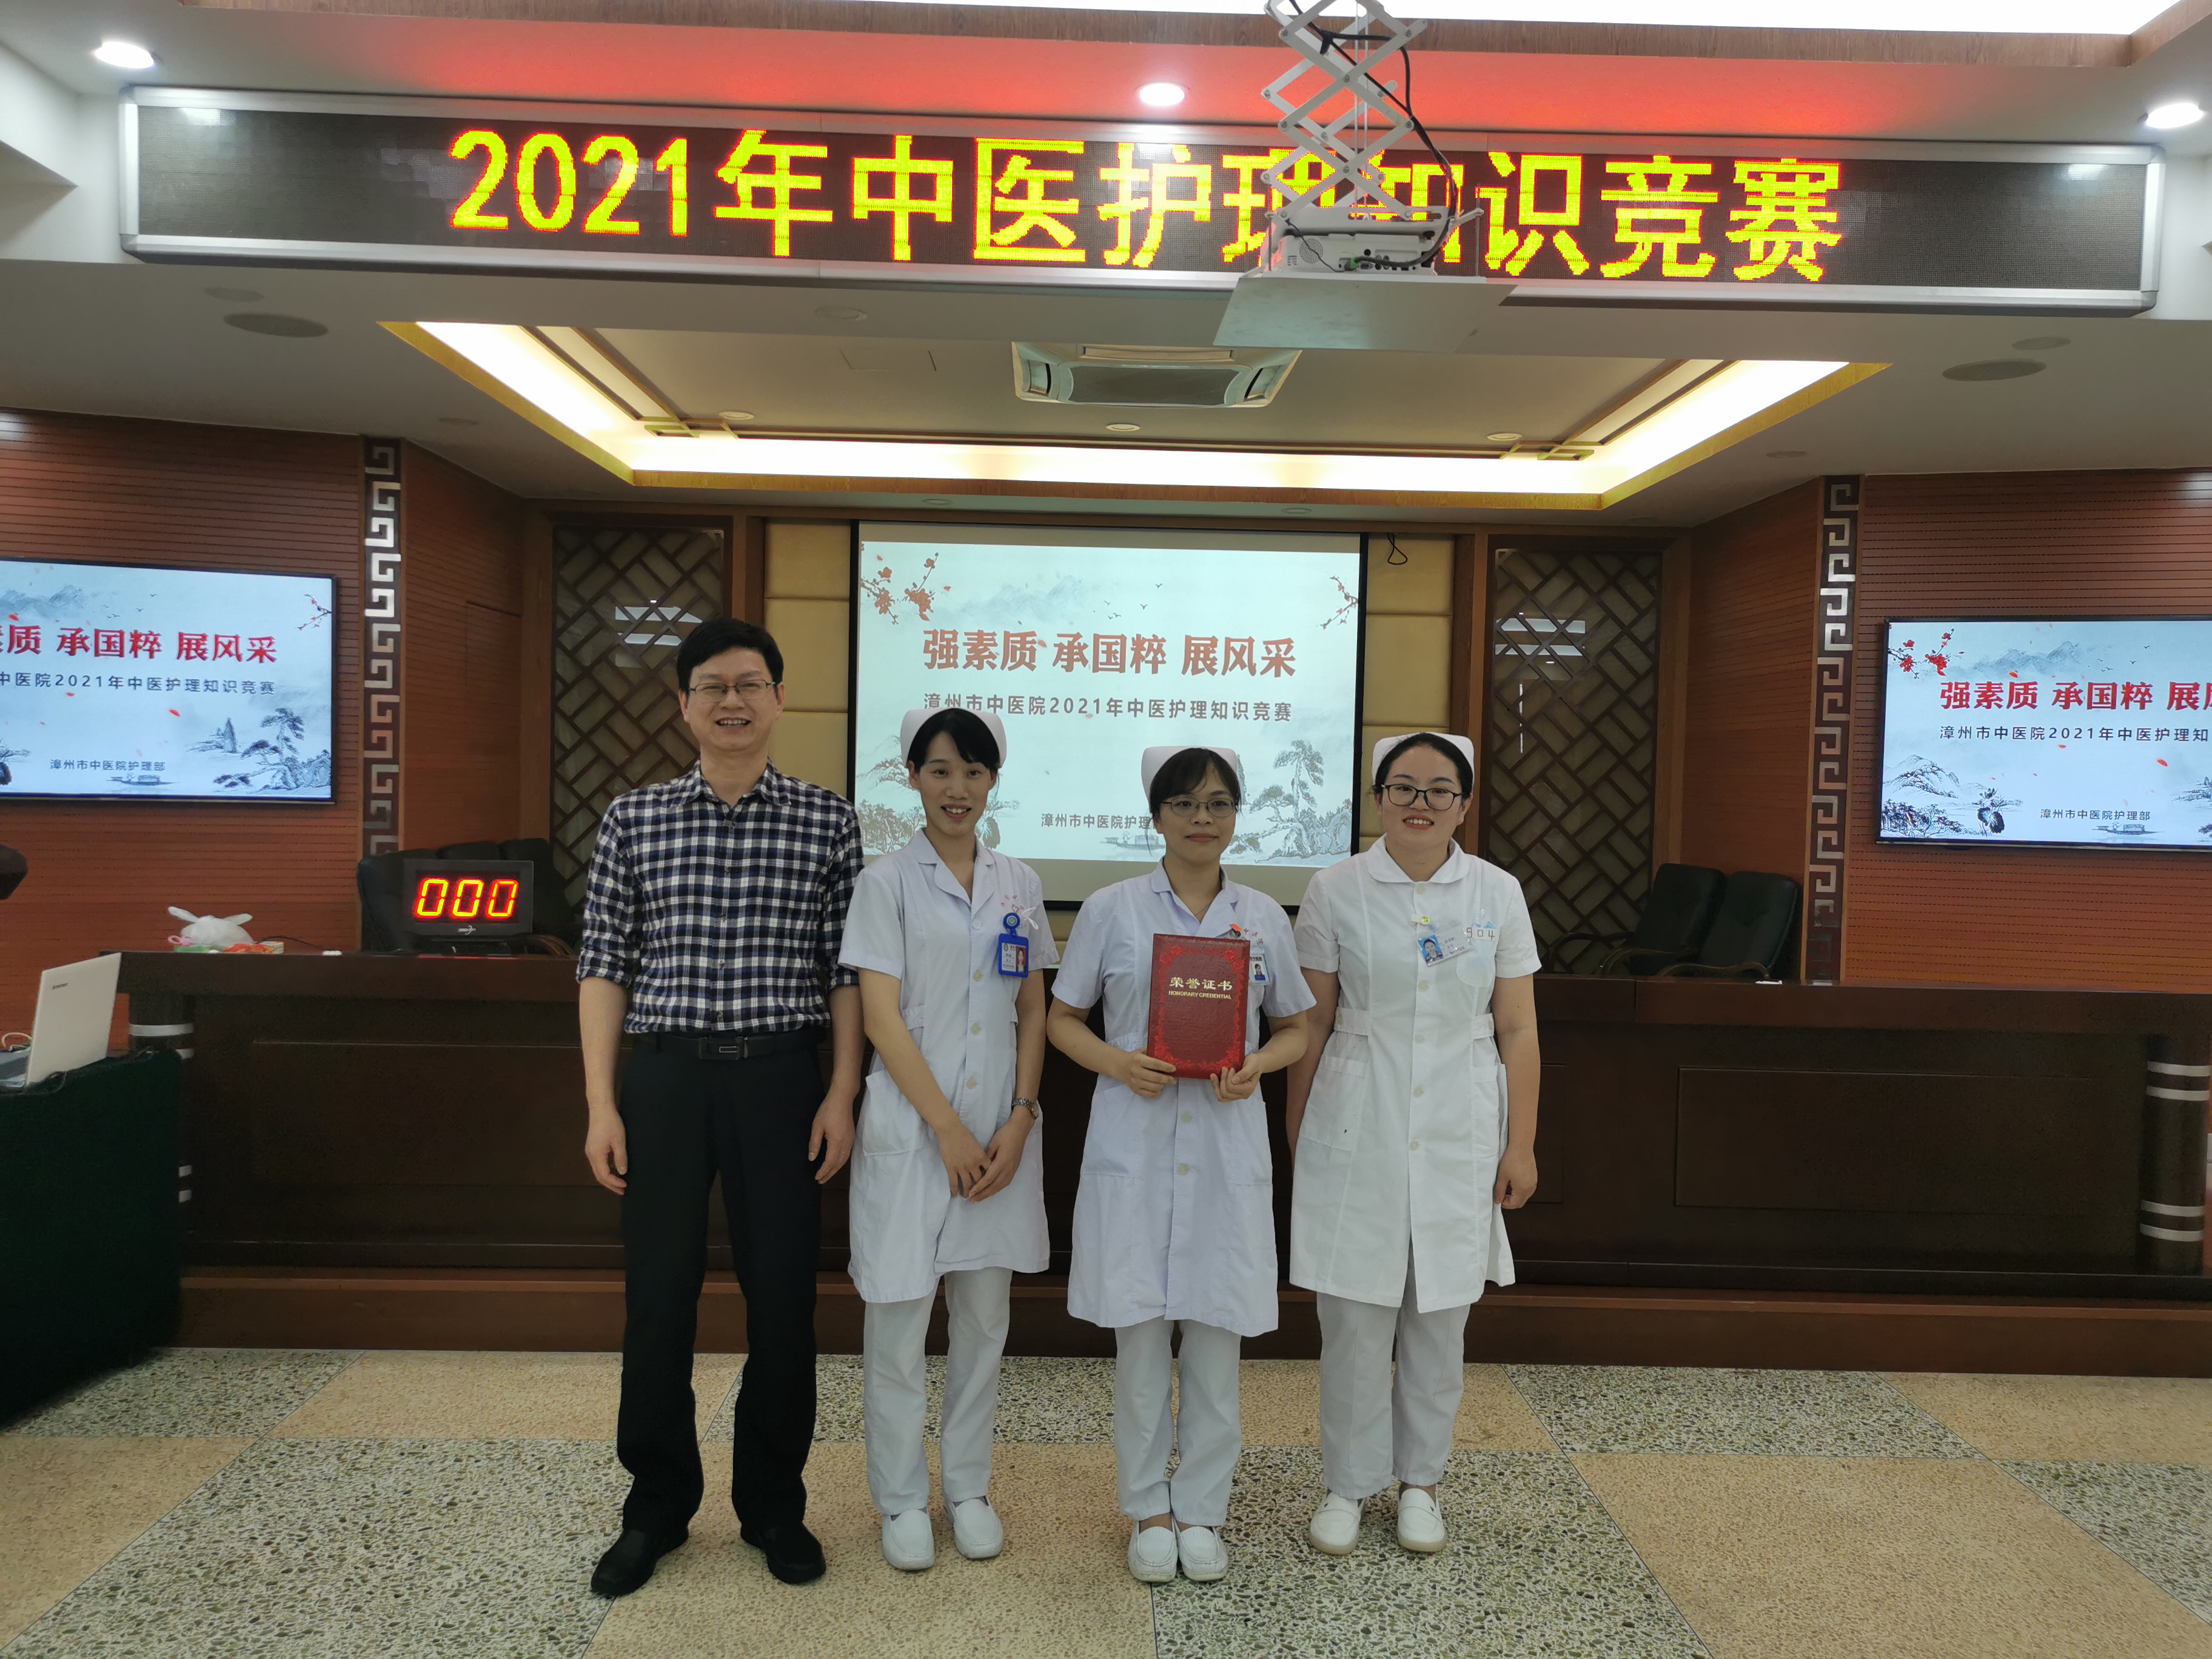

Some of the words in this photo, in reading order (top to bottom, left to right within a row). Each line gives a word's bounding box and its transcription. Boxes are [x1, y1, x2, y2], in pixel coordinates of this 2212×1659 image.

[0, 625, 42, 655] 质
[56, 627, 163, 659] 承国粹
[176, 631, 277, 663] 展风采
[923, 629, 1037, 671] 强素质
[1053, 632, 1167, 674] 承国粹
[1181, 634, 1296, 678] 展风采
[923, 693, 1292, 722] 漳州市中医院2021年中医护理知识竞赛
[1940, 681, 2039, 709] 强素质
[2053, 682, 2153, 710] 承国粹
[2167, 682, 2212, 711] 展
[1940, 726, 2208, 742] 漳州市中医院2021年中医护理知
[50, 759, 166, 773] 漳州市中医院护理部
[1041, 813, 1156, 830] 漳州市中医院护理
[2040, 808, 2151, 822] 漳州市中医院护理部
[415, 878, 518, 917] 000
[1169, 976, 1233, 991] 荣誉证书
